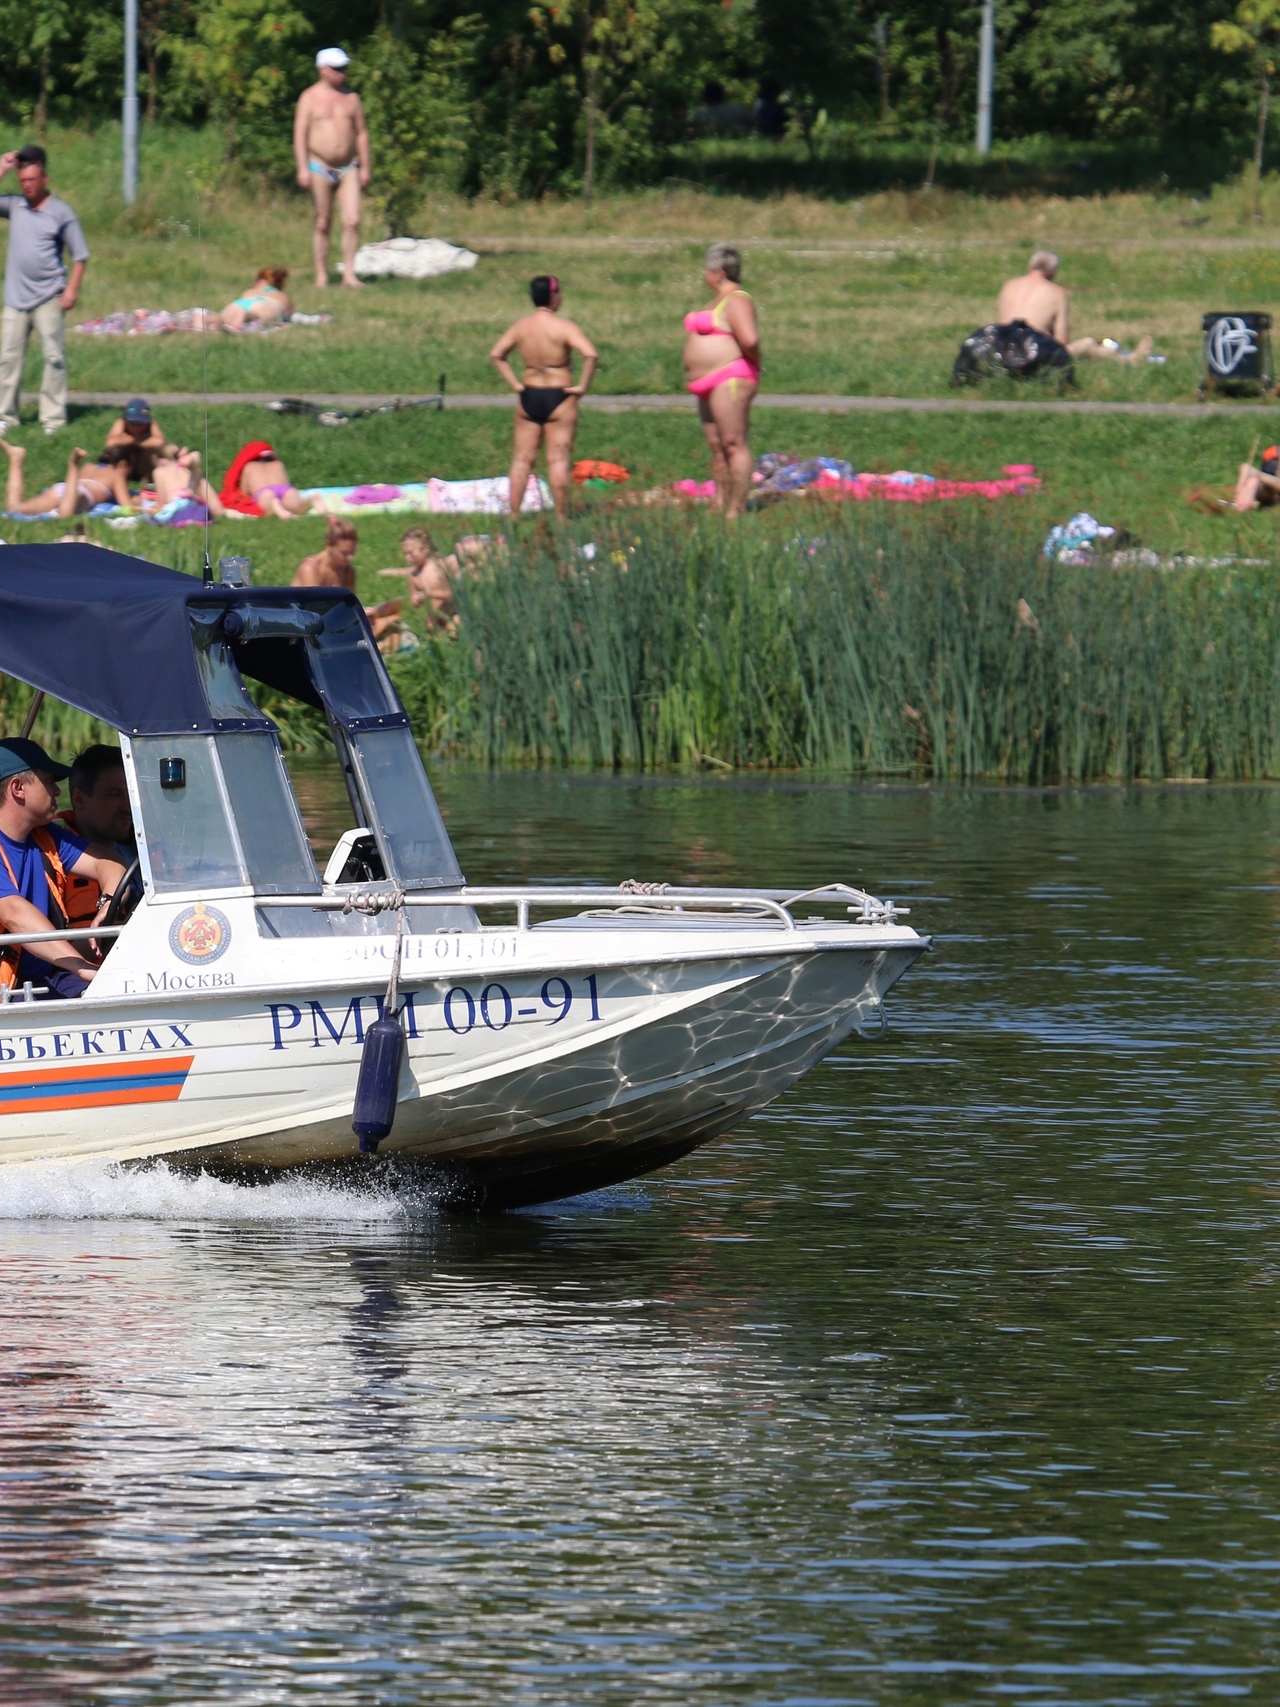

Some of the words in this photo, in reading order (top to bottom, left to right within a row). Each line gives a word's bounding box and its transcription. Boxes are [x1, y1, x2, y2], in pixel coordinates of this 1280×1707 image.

[123, 980, 136, 993] г.
[147, 971, 235, 992] Москва
[443, 973, 605, 1035] 00-91
